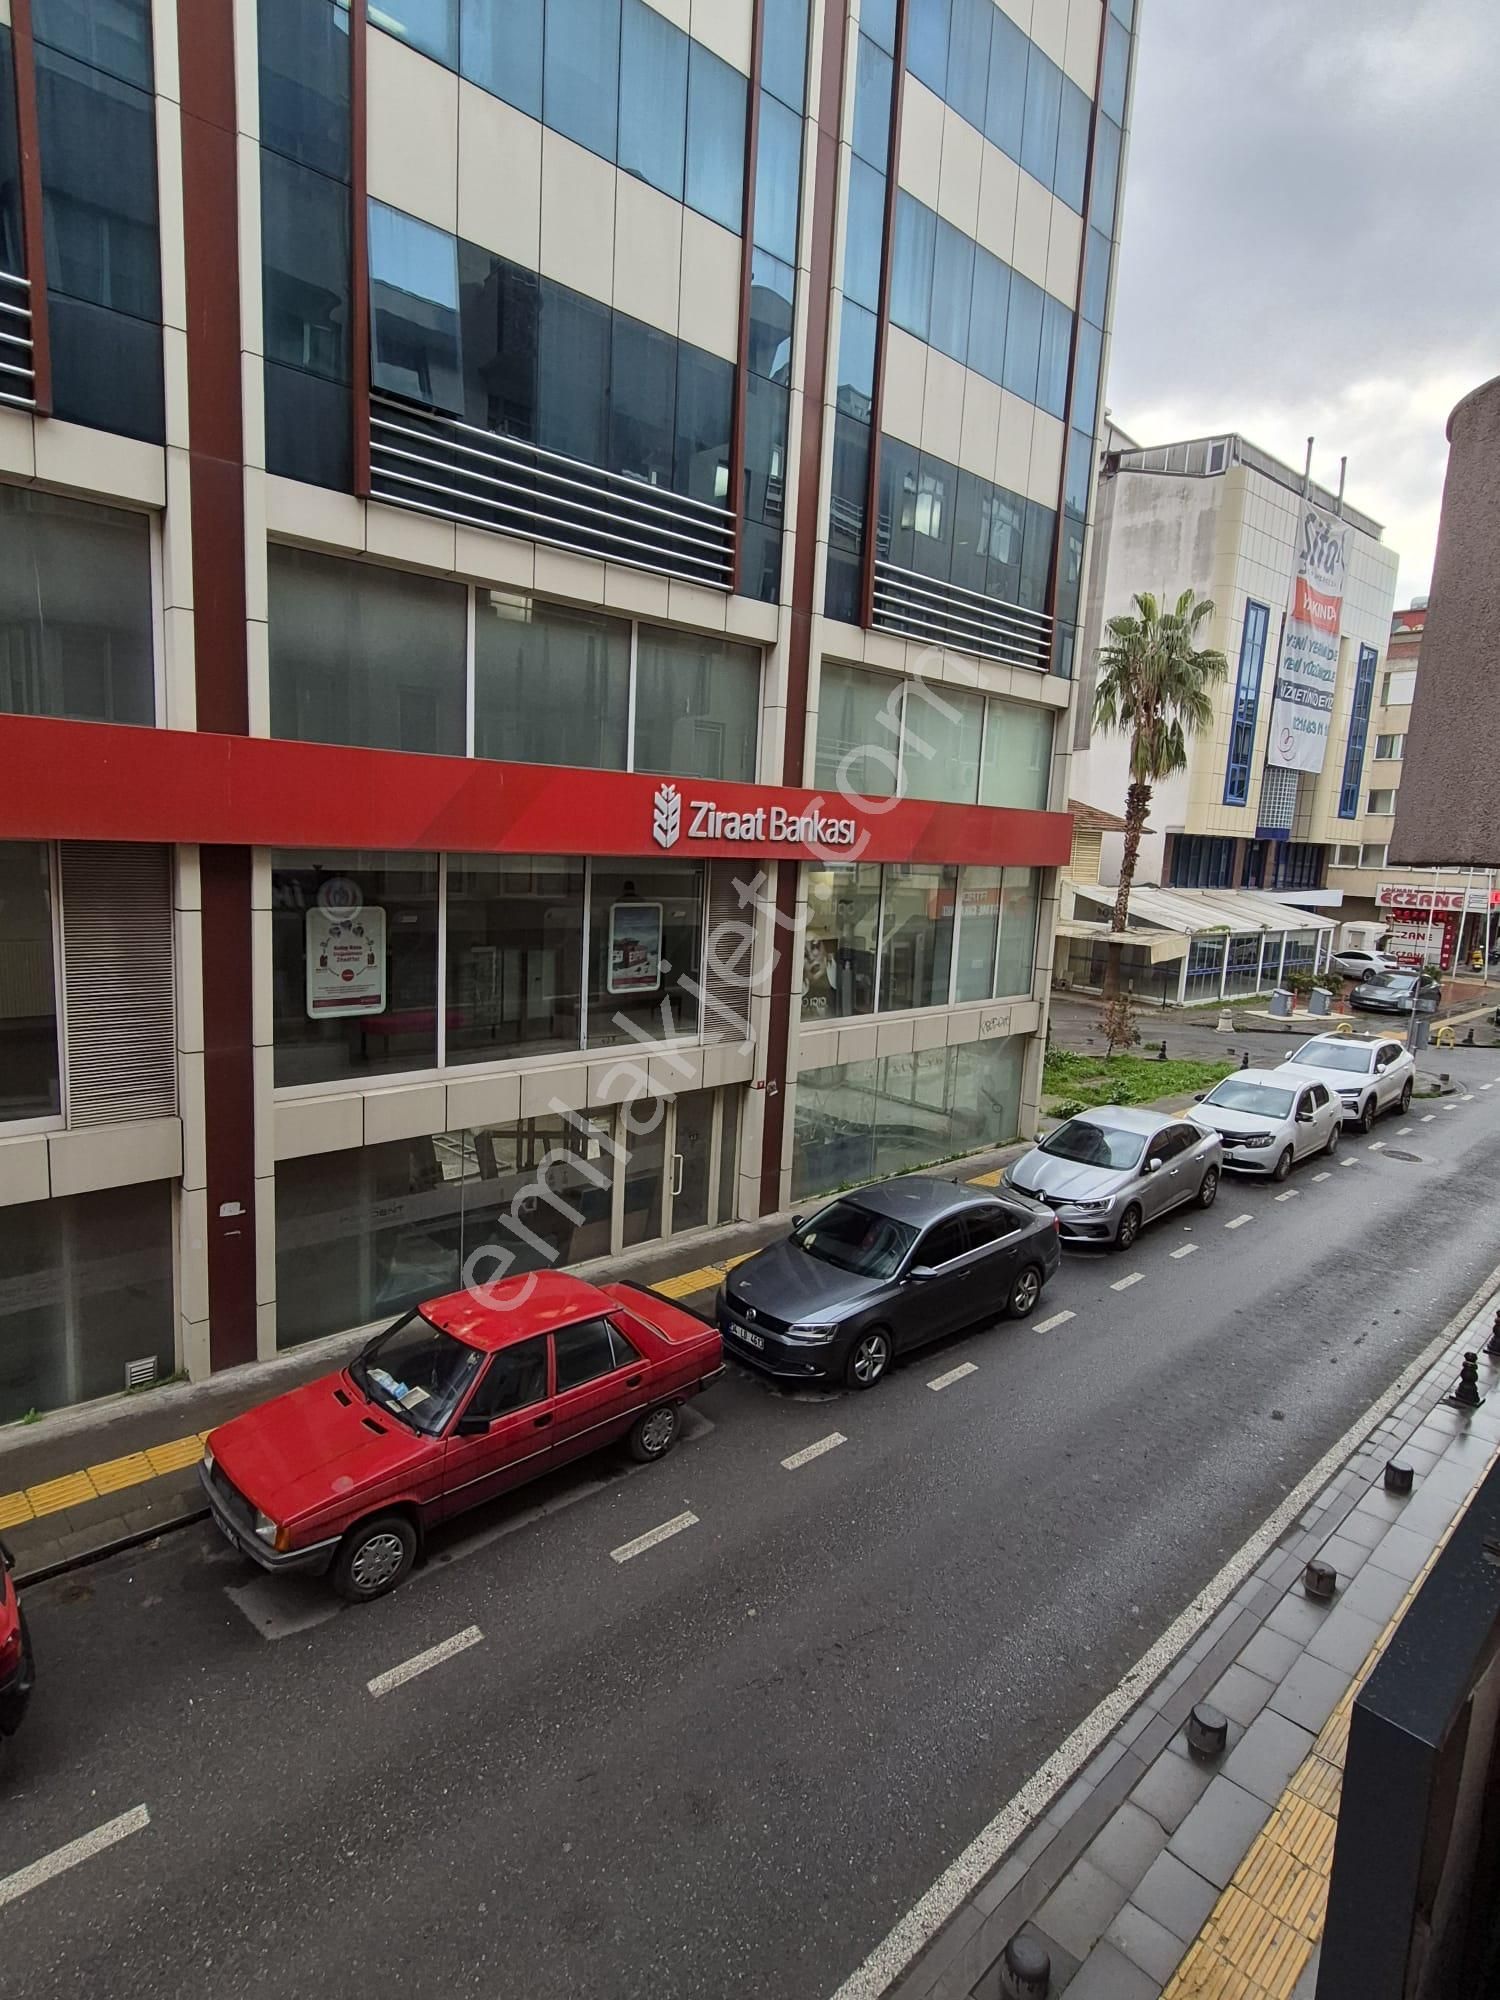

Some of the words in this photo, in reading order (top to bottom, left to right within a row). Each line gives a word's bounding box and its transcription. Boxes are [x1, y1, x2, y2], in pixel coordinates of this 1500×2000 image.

[688, 800, 766, 842] Ziraat
[769, 806, 855, 844] Bankası
[1380, 893, 1465, 909] ECZANE
